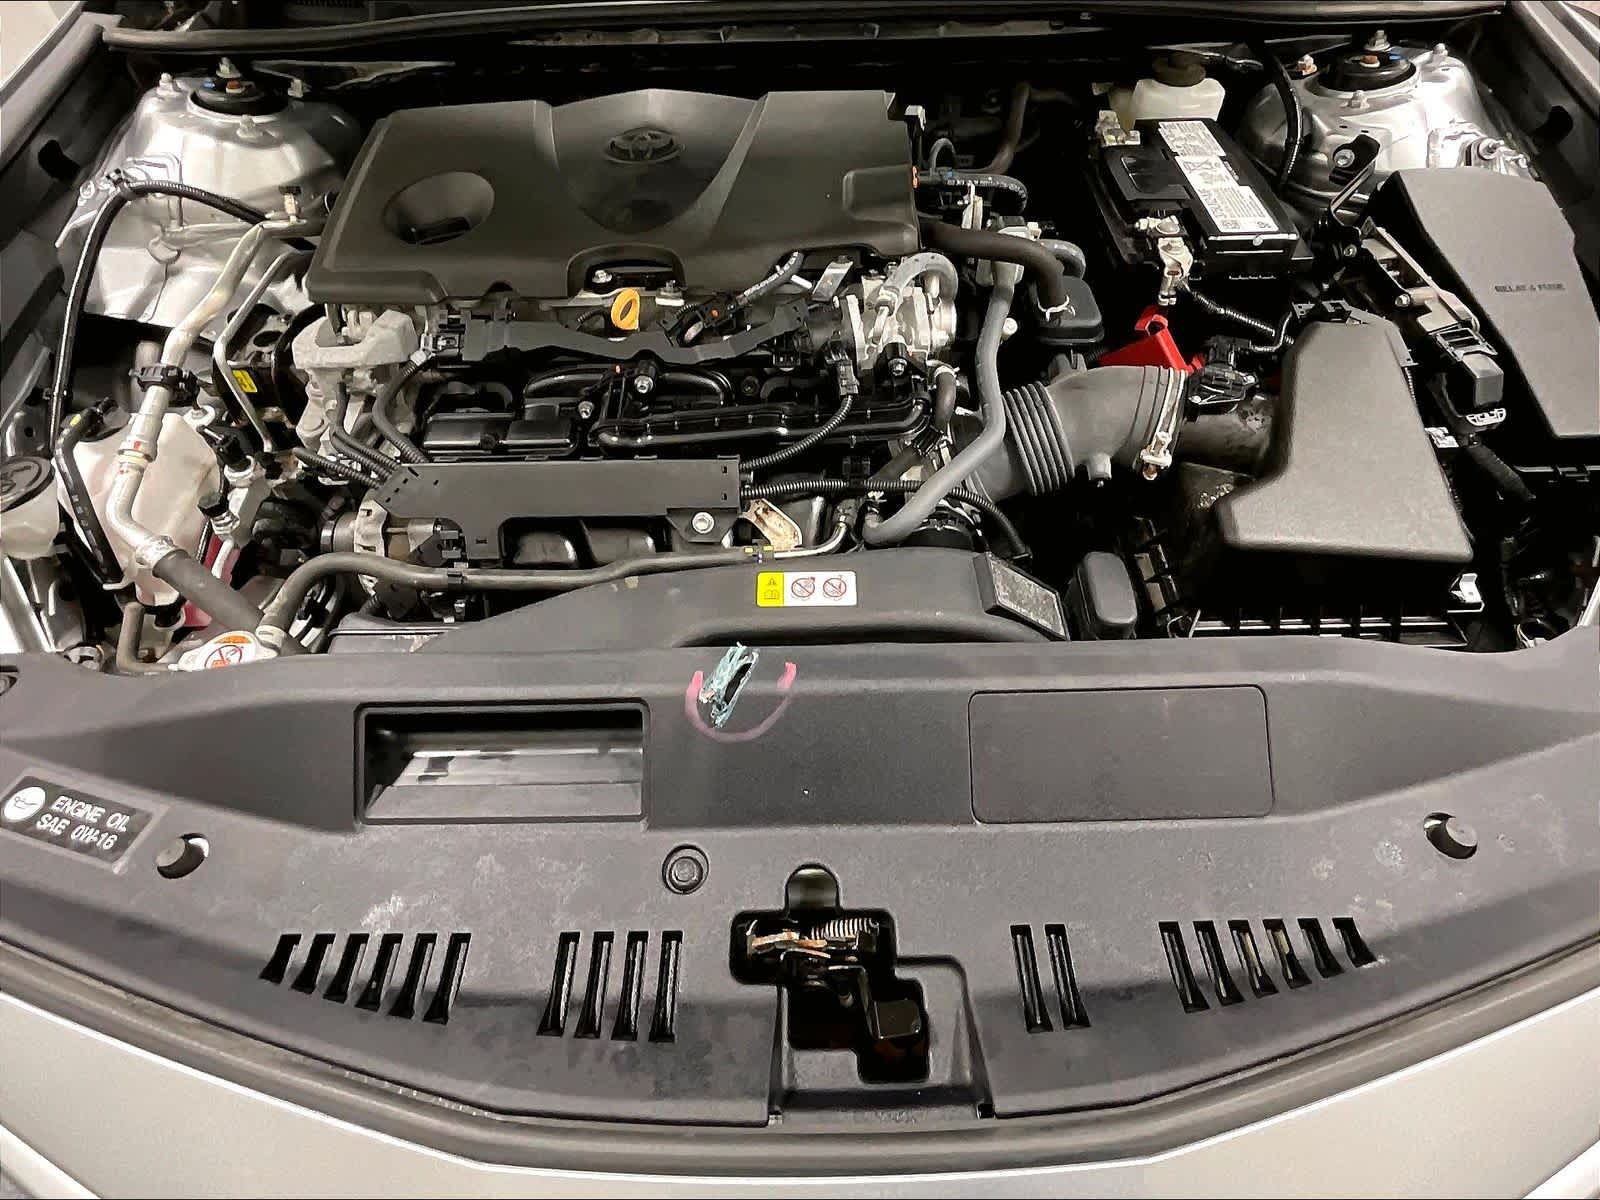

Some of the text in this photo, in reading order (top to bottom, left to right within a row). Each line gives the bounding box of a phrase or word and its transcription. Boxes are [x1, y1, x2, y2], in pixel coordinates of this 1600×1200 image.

[36, 813, 118, 850] SAE 0W-16
[51, 795, 130, 833] ENGINE OIL
